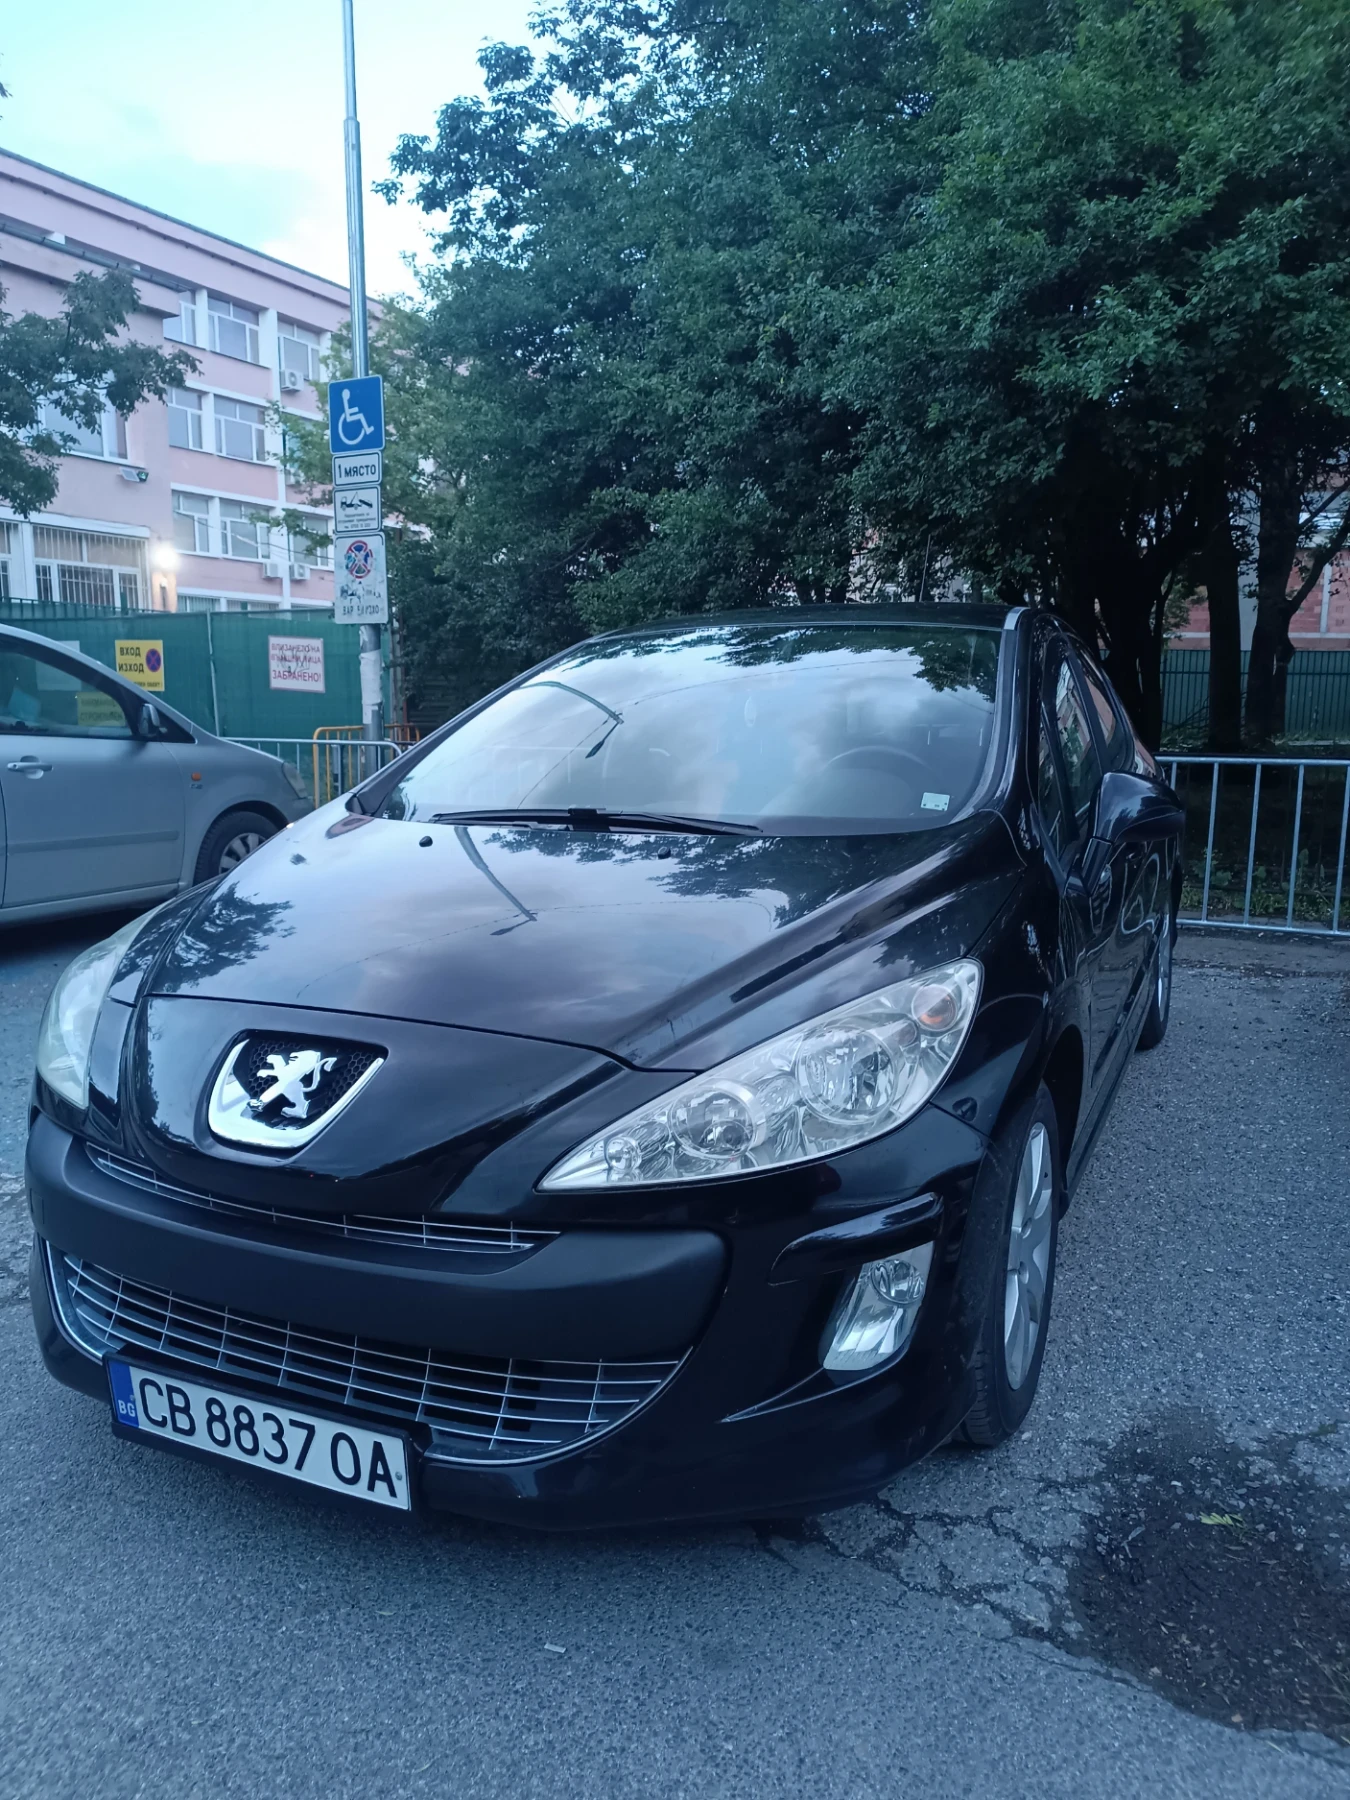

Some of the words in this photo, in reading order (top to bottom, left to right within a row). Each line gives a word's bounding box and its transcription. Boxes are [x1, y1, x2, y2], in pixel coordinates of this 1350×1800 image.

[338, 464, 342, 478] 1
[344, 464, 377, 477] МЯСТО
[119, 647, 141, 658] ВХОД
[118, 663, 144, 673] ИЗХОД
[272, 669, 322, 682] ЗАБРАНЕНО!
[118, 1399, 136, 1418] BG
[138, 1377, 197, 1437] CB
[205, 1397, 316, 1471] 8837
